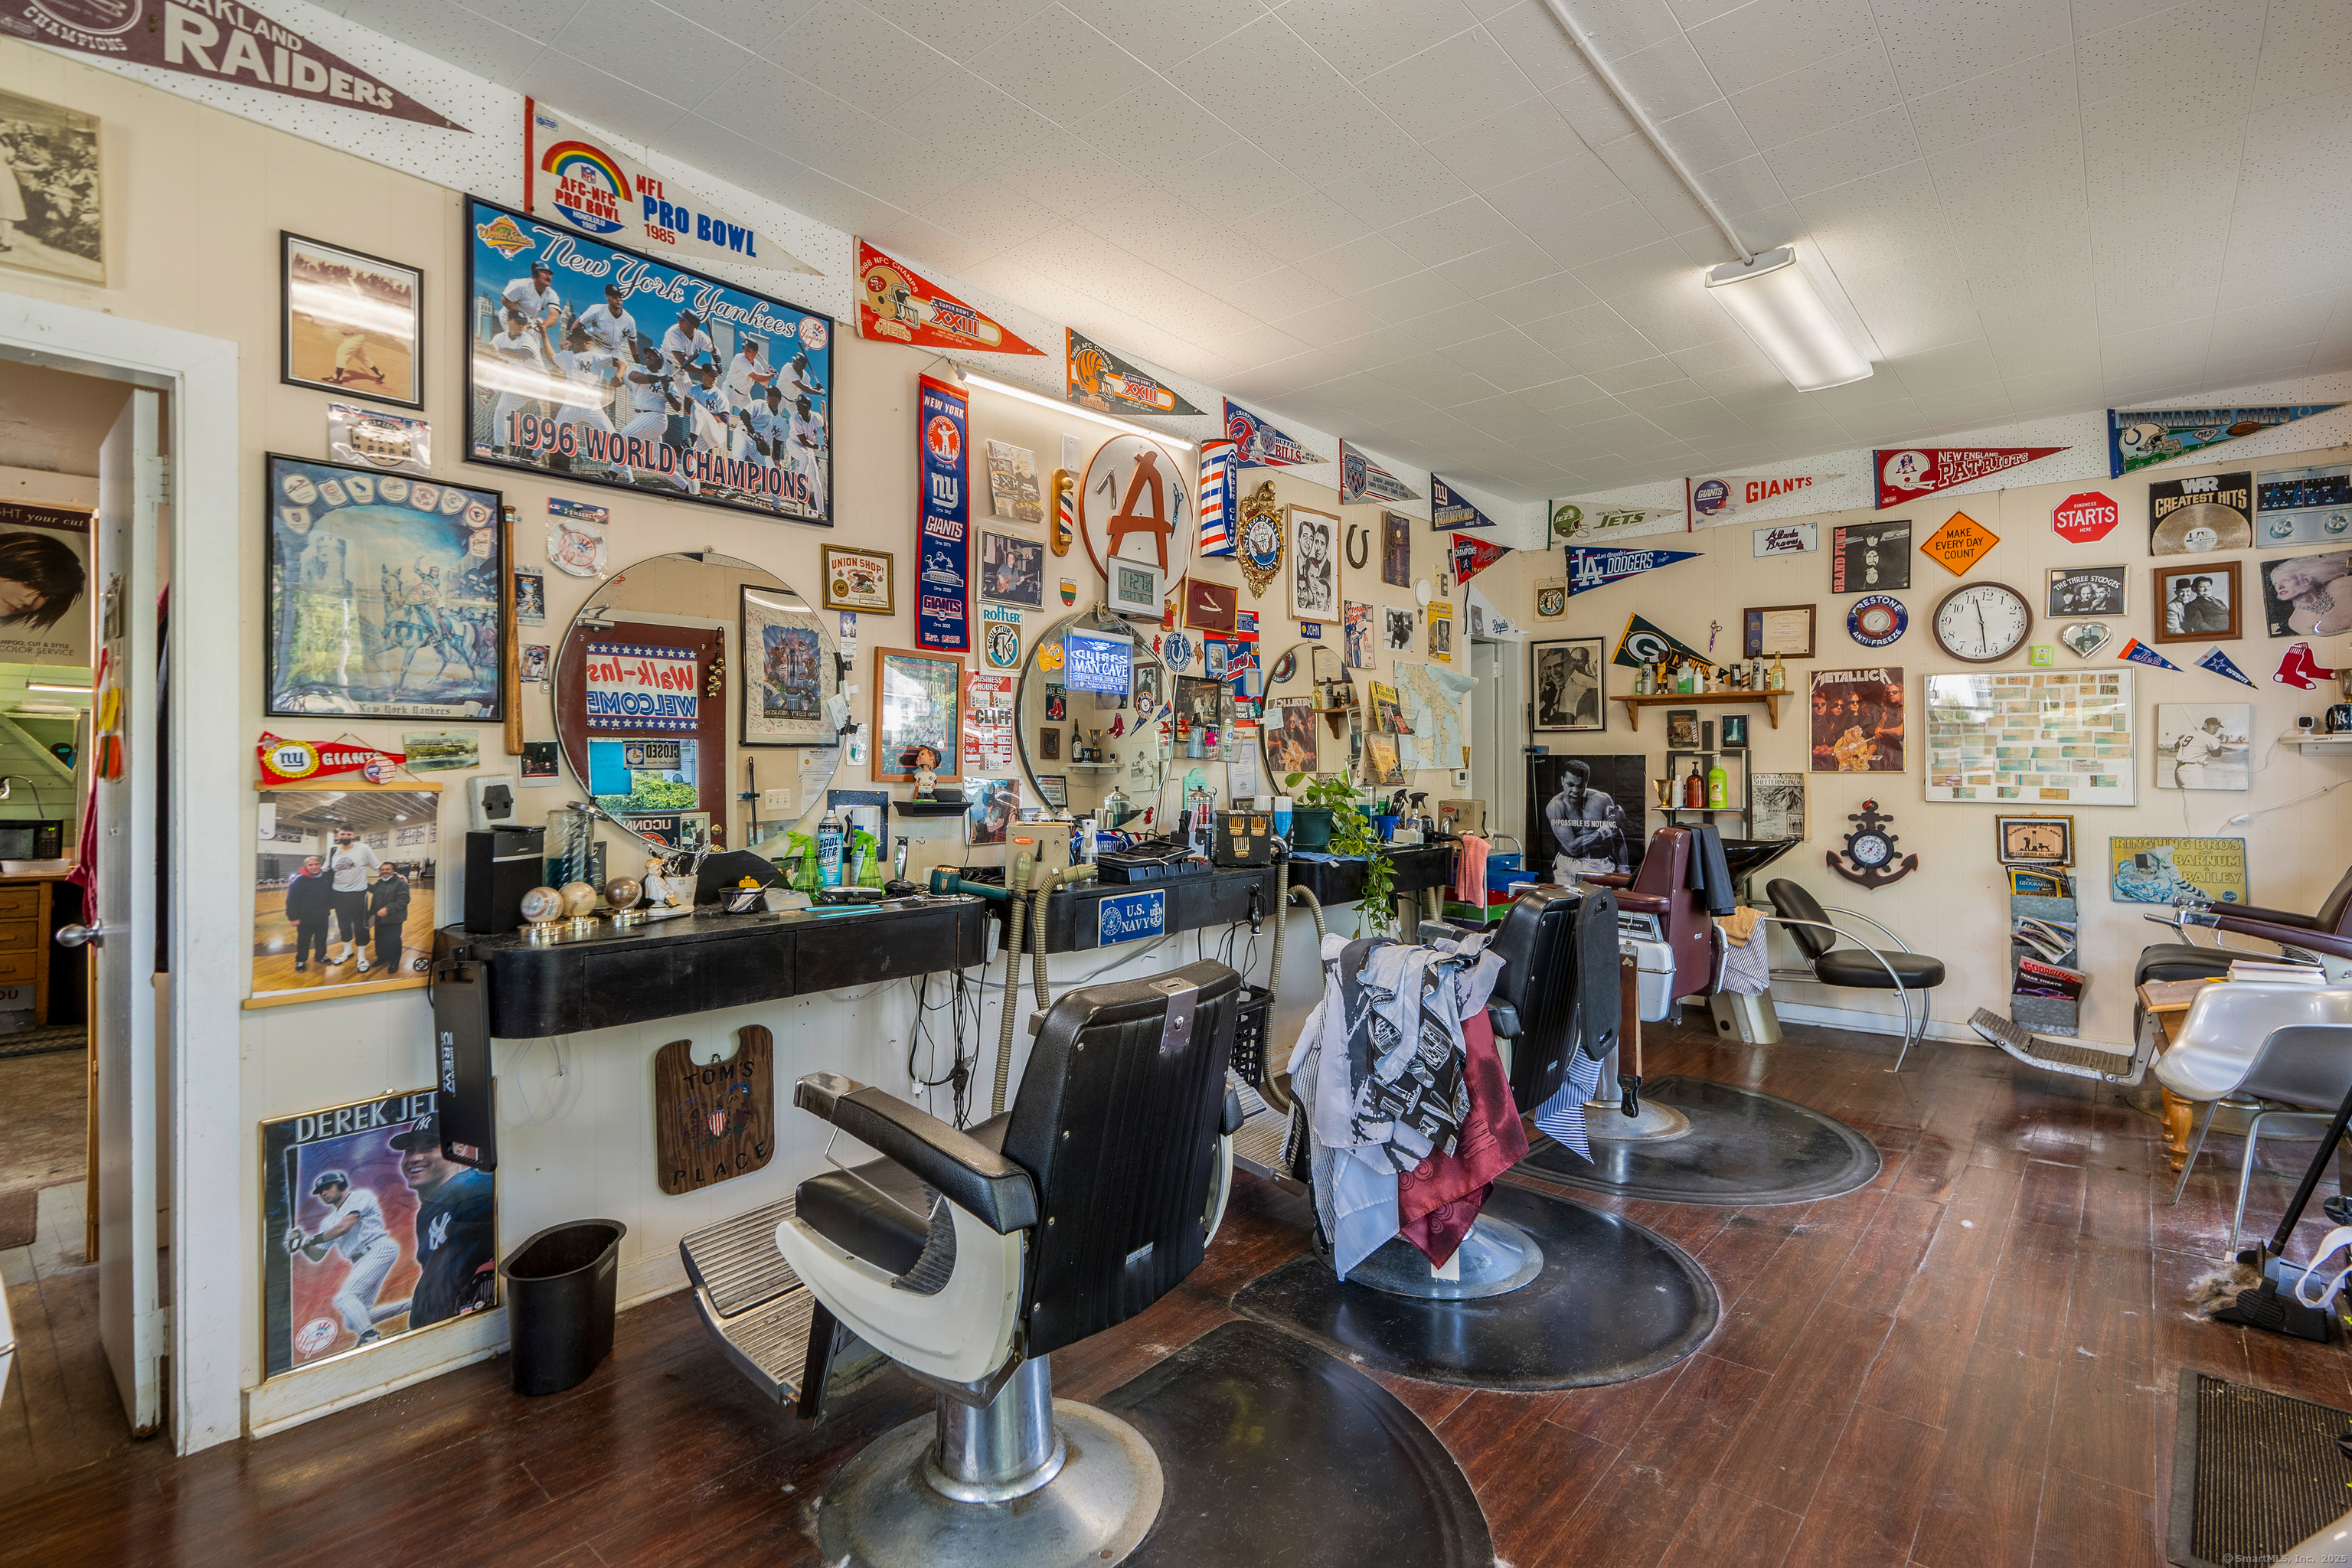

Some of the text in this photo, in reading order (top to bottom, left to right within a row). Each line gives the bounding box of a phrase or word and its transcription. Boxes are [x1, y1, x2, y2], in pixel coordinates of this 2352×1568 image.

[23, 6, 128, 51] CHAMPIONS
[170, 0, 302, 51] AKLAND
[163, 1, 394, 109] RAIDERS
[560, 175, 616, 207] AFC-NFC
[636, 174, 665, 201] NFL
[555, 188, 621, 223] PRO BOWL
[572, 210, 606, 227] HONOLULU
[581, 220, 597, 231] 1985
[643, 194, 756, 258] PRO BOWL
[643, 223, 676, 246] 1985
[534, 227, 795, 338] New York Yankees
[892, 261, 919, 292] CHAMPS
[932, 307, 978, 337] XXIII
[874, 322, 912, 341] 49ERS
[1094, 345, 1114, 370] CHAMPS
[1123, 381, 1158, 404] XXIII
[924, 395, 965, 419] NEW YORK
[1080, 396, 1109, 412] BENGALS
[1236, 410, 1257, 428] CHAMPIONS
[2118, 407, 2291, 428] INDIANAPOLIS COLTS
[1276, 438, 1302, 450] BUFFALO
[506, 410, 810, 503] 1996 WORLD CHAMPIONS
[1275, 444, 1302, 463] BILLS
[1938, 452, 1962, 462] NEW
[1938, 452, 2028, 488] PATRIOTS
[1697, 488, 1723, 498] GIANTS
[1746, 477, 1812, 504] GIANTS
[2180, 476, 2219, 494] WAR
[2155, 488, 2247, 518] GREATEST HITS
[25, 513, 84, 528] your cut
[1436, 508, 1475, 525] CHAMPIONS
[1593, 512, 1645, 529] JETS
[2056, 506, 2115, 528] STARTS
[925, 514, 964, 538] GIANTS
[1947, 528, 1971, 538] MAKE
[1243, 514, 1281, 556] UNITED STATES
[1766, 528, 1798, 541] Atlanta
[1834, 528, 1846, 556] FUNK
[1766, 538, 1798, 551] Braves
[1936, 537, 1984, 550] EVERY DAY
[1455, 547, 1477, 557] CHAMPIONS
[1607, 550, 1627, 559] Angeles
[1945, 548, 1975, 560] COUNT
[831, 557, 884, 577] UNION SHOP!
[1257, 558, 1278, 572] NAVY
[1576, 549, 1603, 586] LA
[1607, 552, 1654, 573] DODGERS
[1124, 572, 1145, 590] 11:27
[1834, 557, 1846, 592] GRAND
[2053, 576, 2121, 591] THE THREE STOOGES
[923, 595, 962, 613] GIANTS
[1540, 590, 1559, 606] SCULPTUR
[1965, 595, 1975, 604] 11
[1981, 592, 1994, 601] 12
[2000, 596, 2004, 605] 1
[1953, 604, 1964, 613] 10
[2009, 606, 2017, 615] 2
[1492, 619, 1508, 635] Royals
[1945, 616, 1952, 626] 9
[2013, 620, 2020, 629] 3
[988, 626, 1011, 649] SCULPTUR
[1306, 625, 1320, 637] JOHN
[1853, 629, 1903, 646] ANTI-FREEZE
[1948, 630, 1955, 639] 8
[2004, 633, 2011, 642] 4
[941, 635, 960, 644] 1925
[1959, 641, 1966, 650] 7
[1991, 642, 1998, 652] 5
[38, 648, 74, 657] SERVICE
[1975, 645, 1981, 654] 6
[2132, 649, 2163, 666] Mets
[974, 675, 1002, 684] BUSINESS
[1811, 668, 1892, 693] METALLICA
[2226, 667, 2249, 684] COWBOYS
[978, 683, 999, 691] HOURS:
[384, 704, 451, 716] York Yankees
[975, 709, 1011, 725] CLIFF
[2181, 735, 2194, 748] 9
[1551, 818, 1618, 829] IMPOSSIBLE IS NOTHING.
[2008, 826, 2026, 836] BARBER
[2050, 829, 2062, 838] AGES
[2195, 839, 2241, 850] BROS
[2172, 855, 2240, 867] BARNUM
[2183, 871, 2241, 884] BAILEY
[1126, 904, 1145, 916] U.S.
[1121, 917, 1150, 933] NAVY
[2020, 972, 2038, 981] TEXAS
[443, 1031, 456, 1093] CREW
[683, 1060, 755, 1092] TOM'S
[296, 1100, 388, 1143] DEREK
[673, 1140, 766, 1187] PLACE
